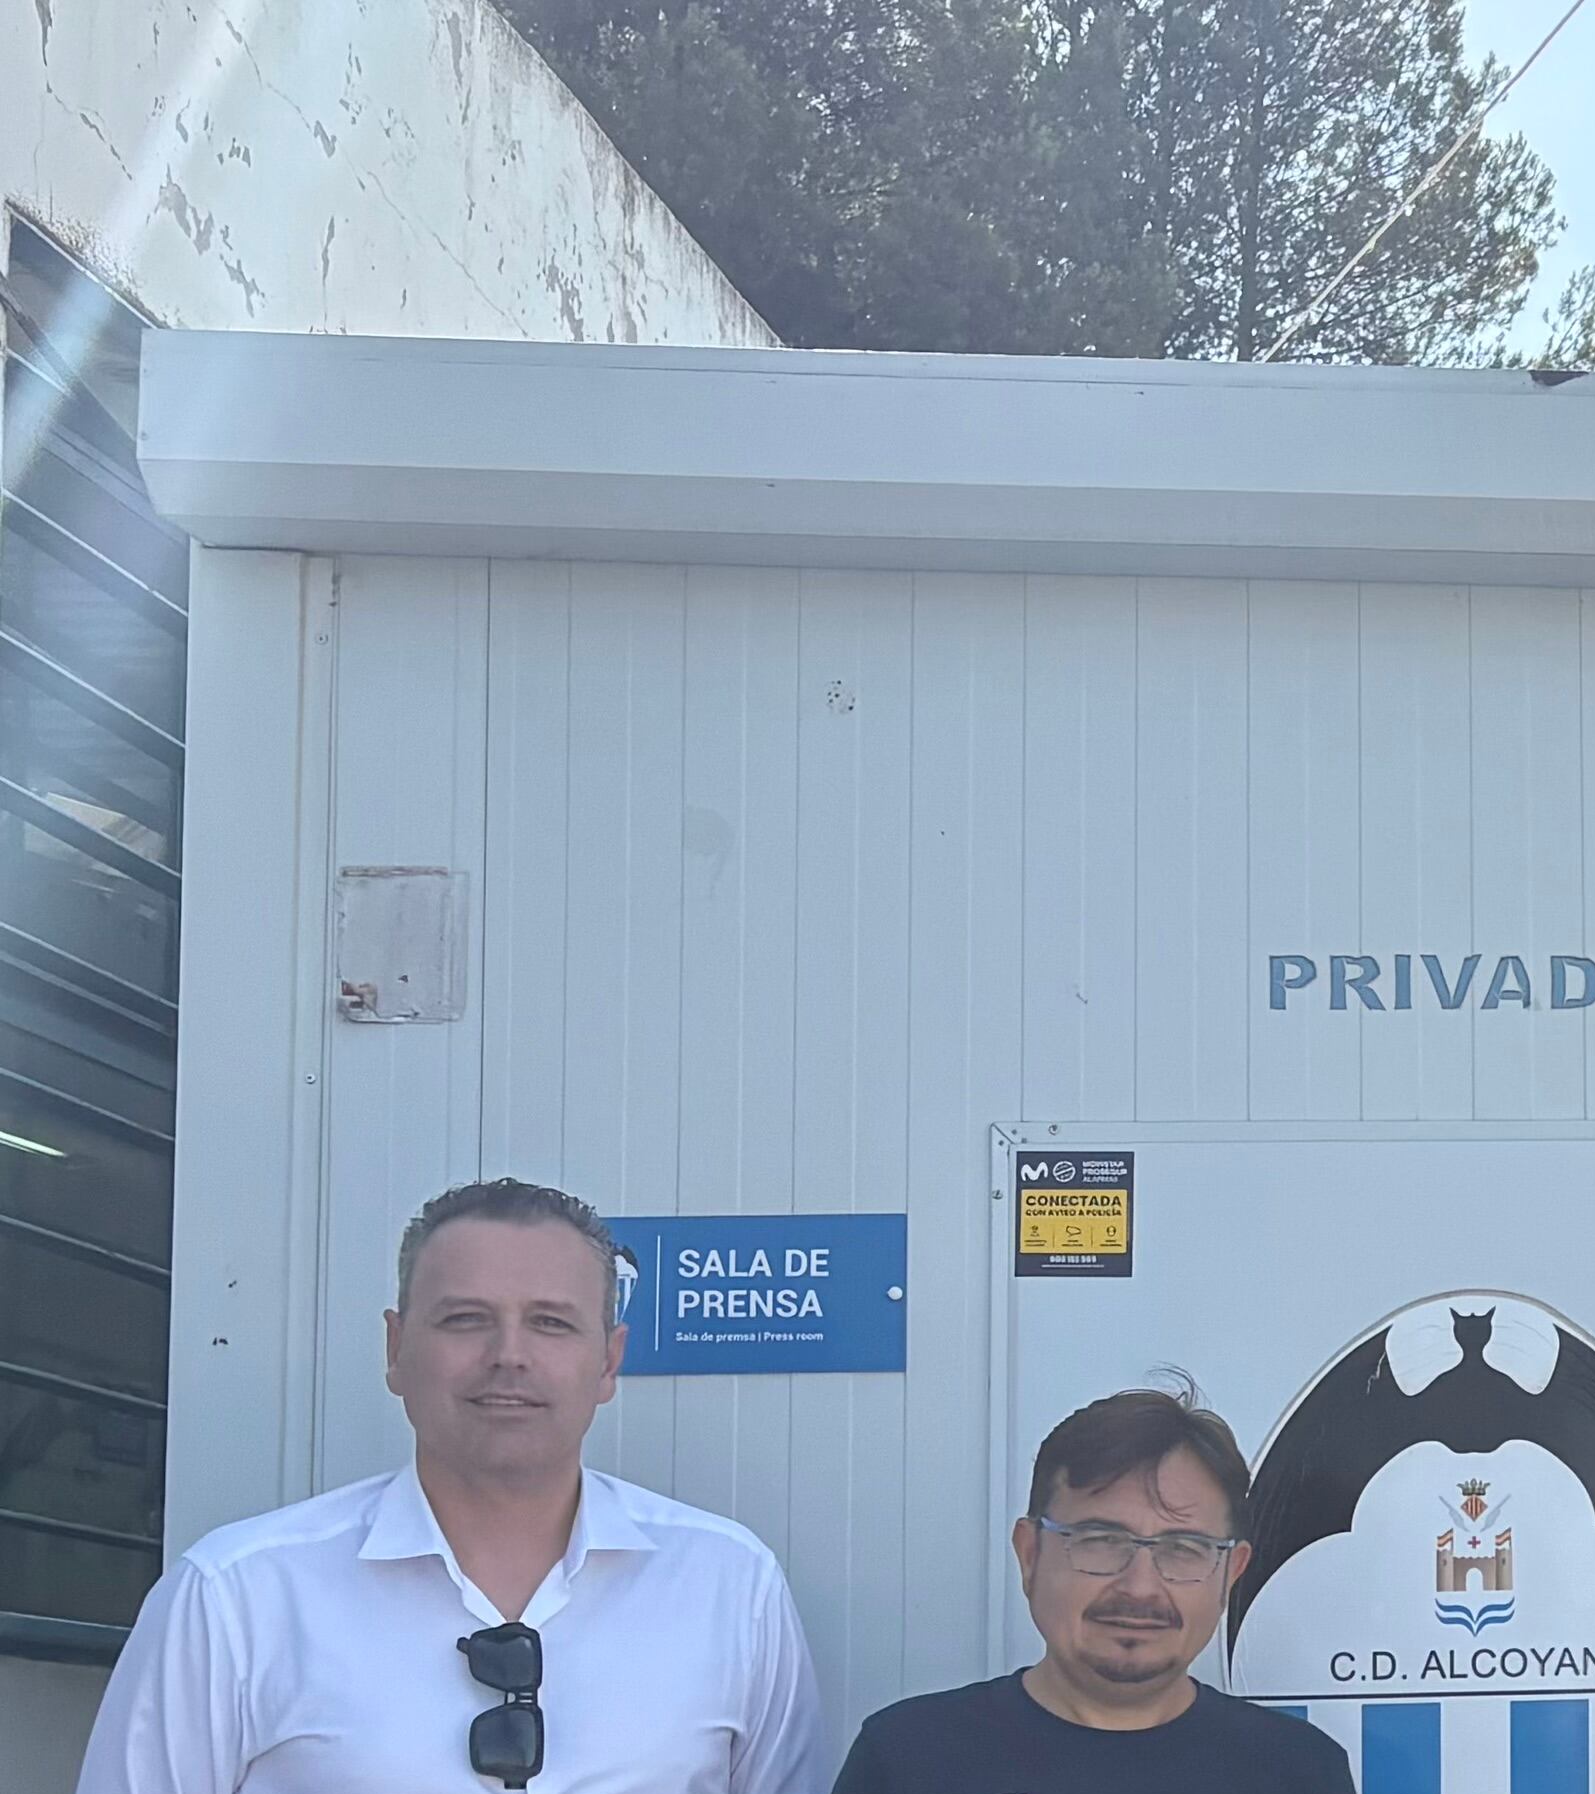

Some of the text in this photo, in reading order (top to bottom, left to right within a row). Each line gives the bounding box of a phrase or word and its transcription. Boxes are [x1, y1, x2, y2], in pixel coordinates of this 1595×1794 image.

[1025, 1195, 1122, 1207] CONECTADA
[678, 1249, 830, 1278] SALA DE
[677, 1289, 824, 1318] PRENSA
[675, 1331, 699, 1342] Sala
[700, 1331, 714, 1342] de
[763, 1331, 794, 1342] Press
[796, 1333, 824, 1342] room
[1329, 1650, 1408, 1682] C.D.
